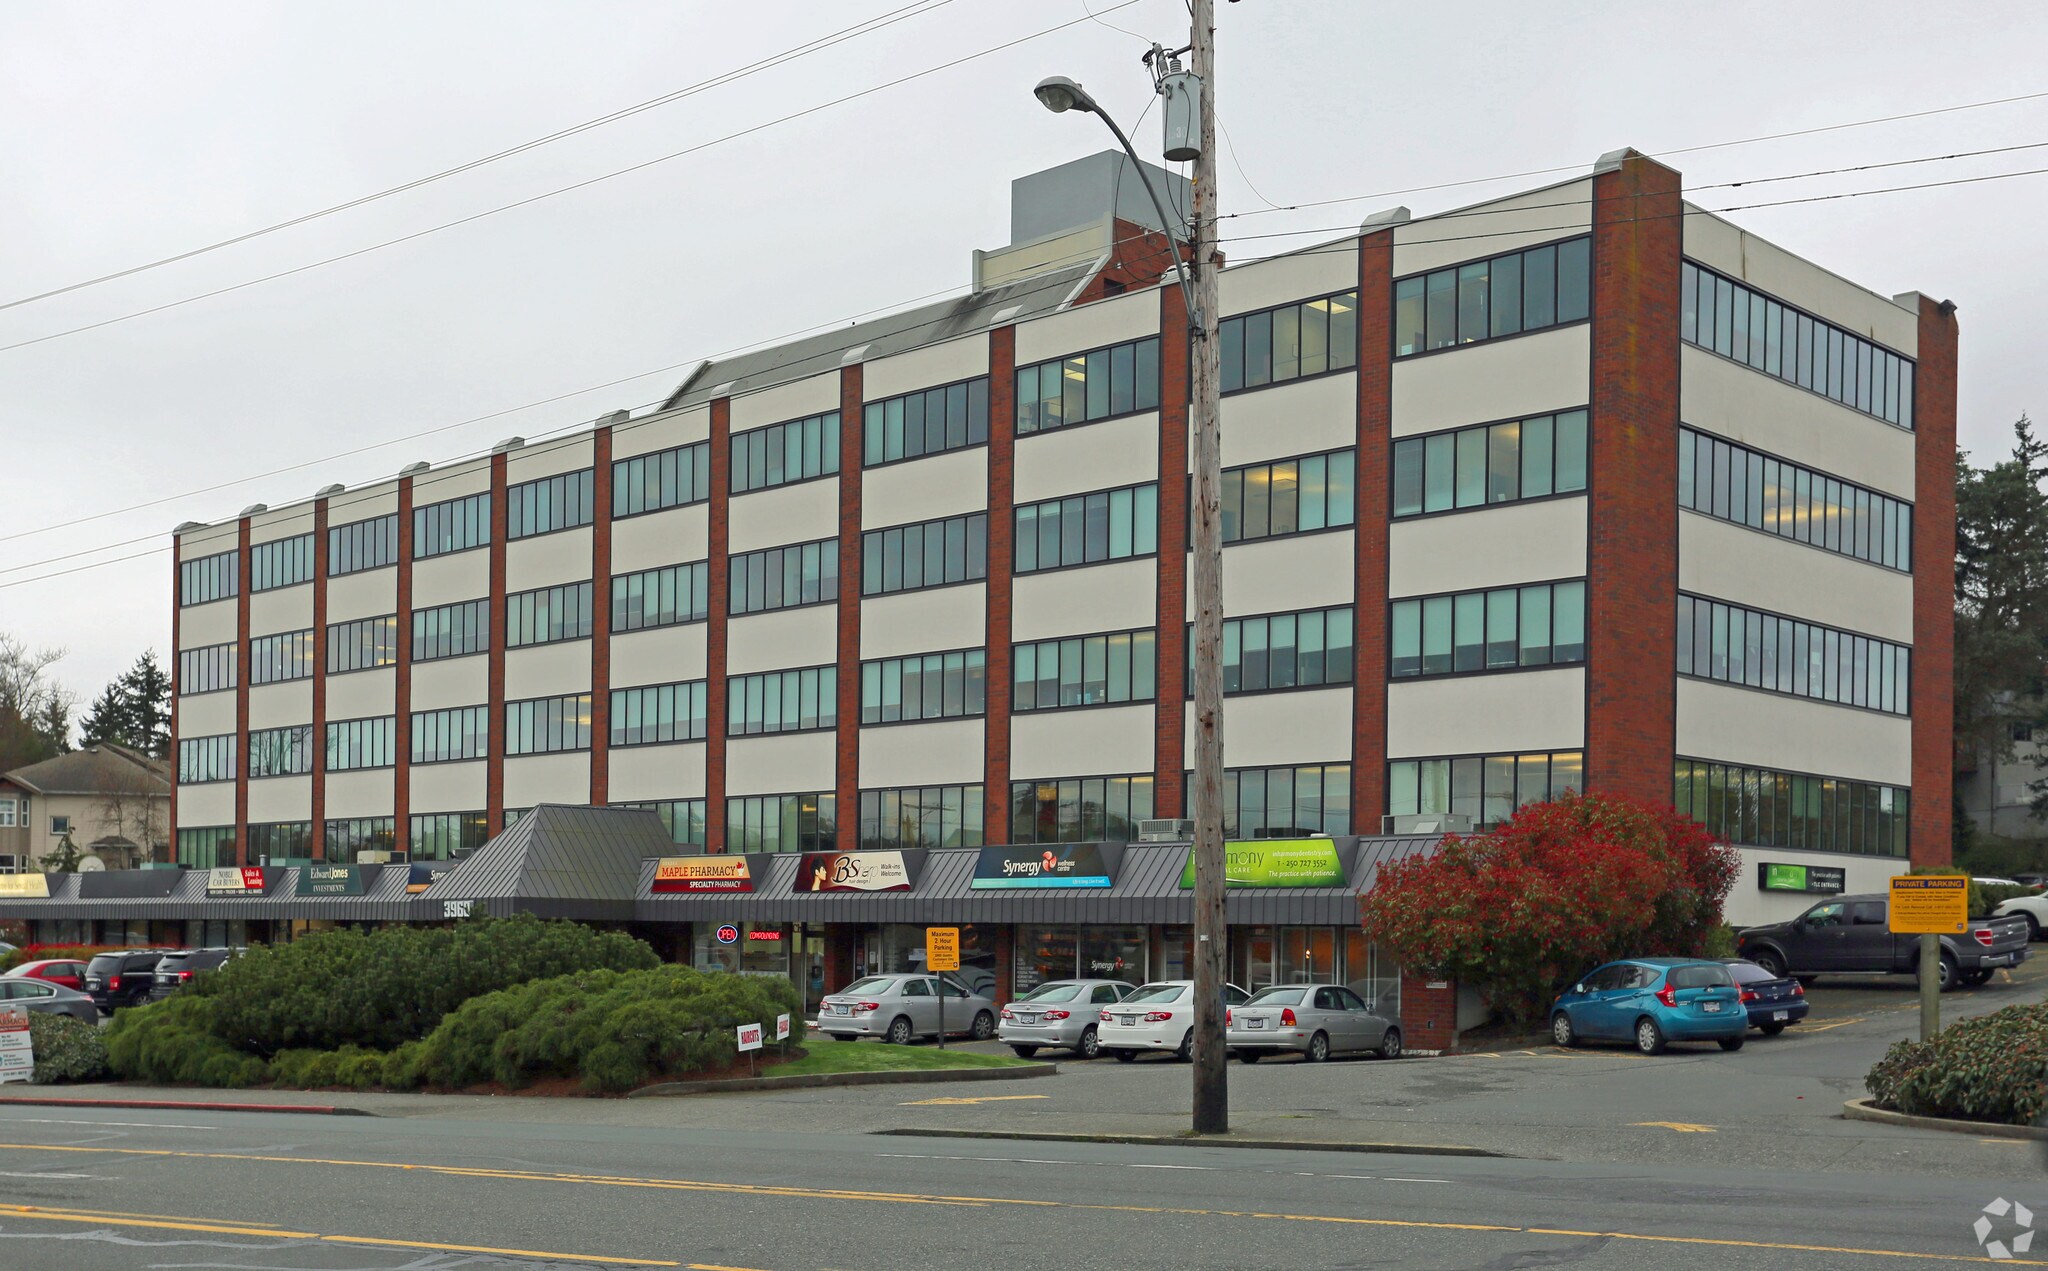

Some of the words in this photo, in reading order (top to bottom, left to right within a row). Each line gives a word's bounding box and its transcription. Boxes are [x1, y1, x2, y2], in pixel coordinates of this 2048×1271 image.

[1003, 859, 1042, 876] Synergy
[1286, 860, 1299, 868] 250
[1300, 860, 1312, 868] 727
[1312, 860, 1327, 868] 3552
[661, 866, 689, 877] MAPLE
[690, 865, 736, 877] PHARMACY
[1278, 870, 1300, 878] practice
[312, 884, 345, 892] INVESTMENTS
[714, 880, 741, 888] PHARMACY
[1894, 880, 1925, 888] PRIVATE
[1927, 880, 1962, 888] PARKING
[720, 929, 736, 940] OPEN
[1091, 960, 1115, 972] Synergy
